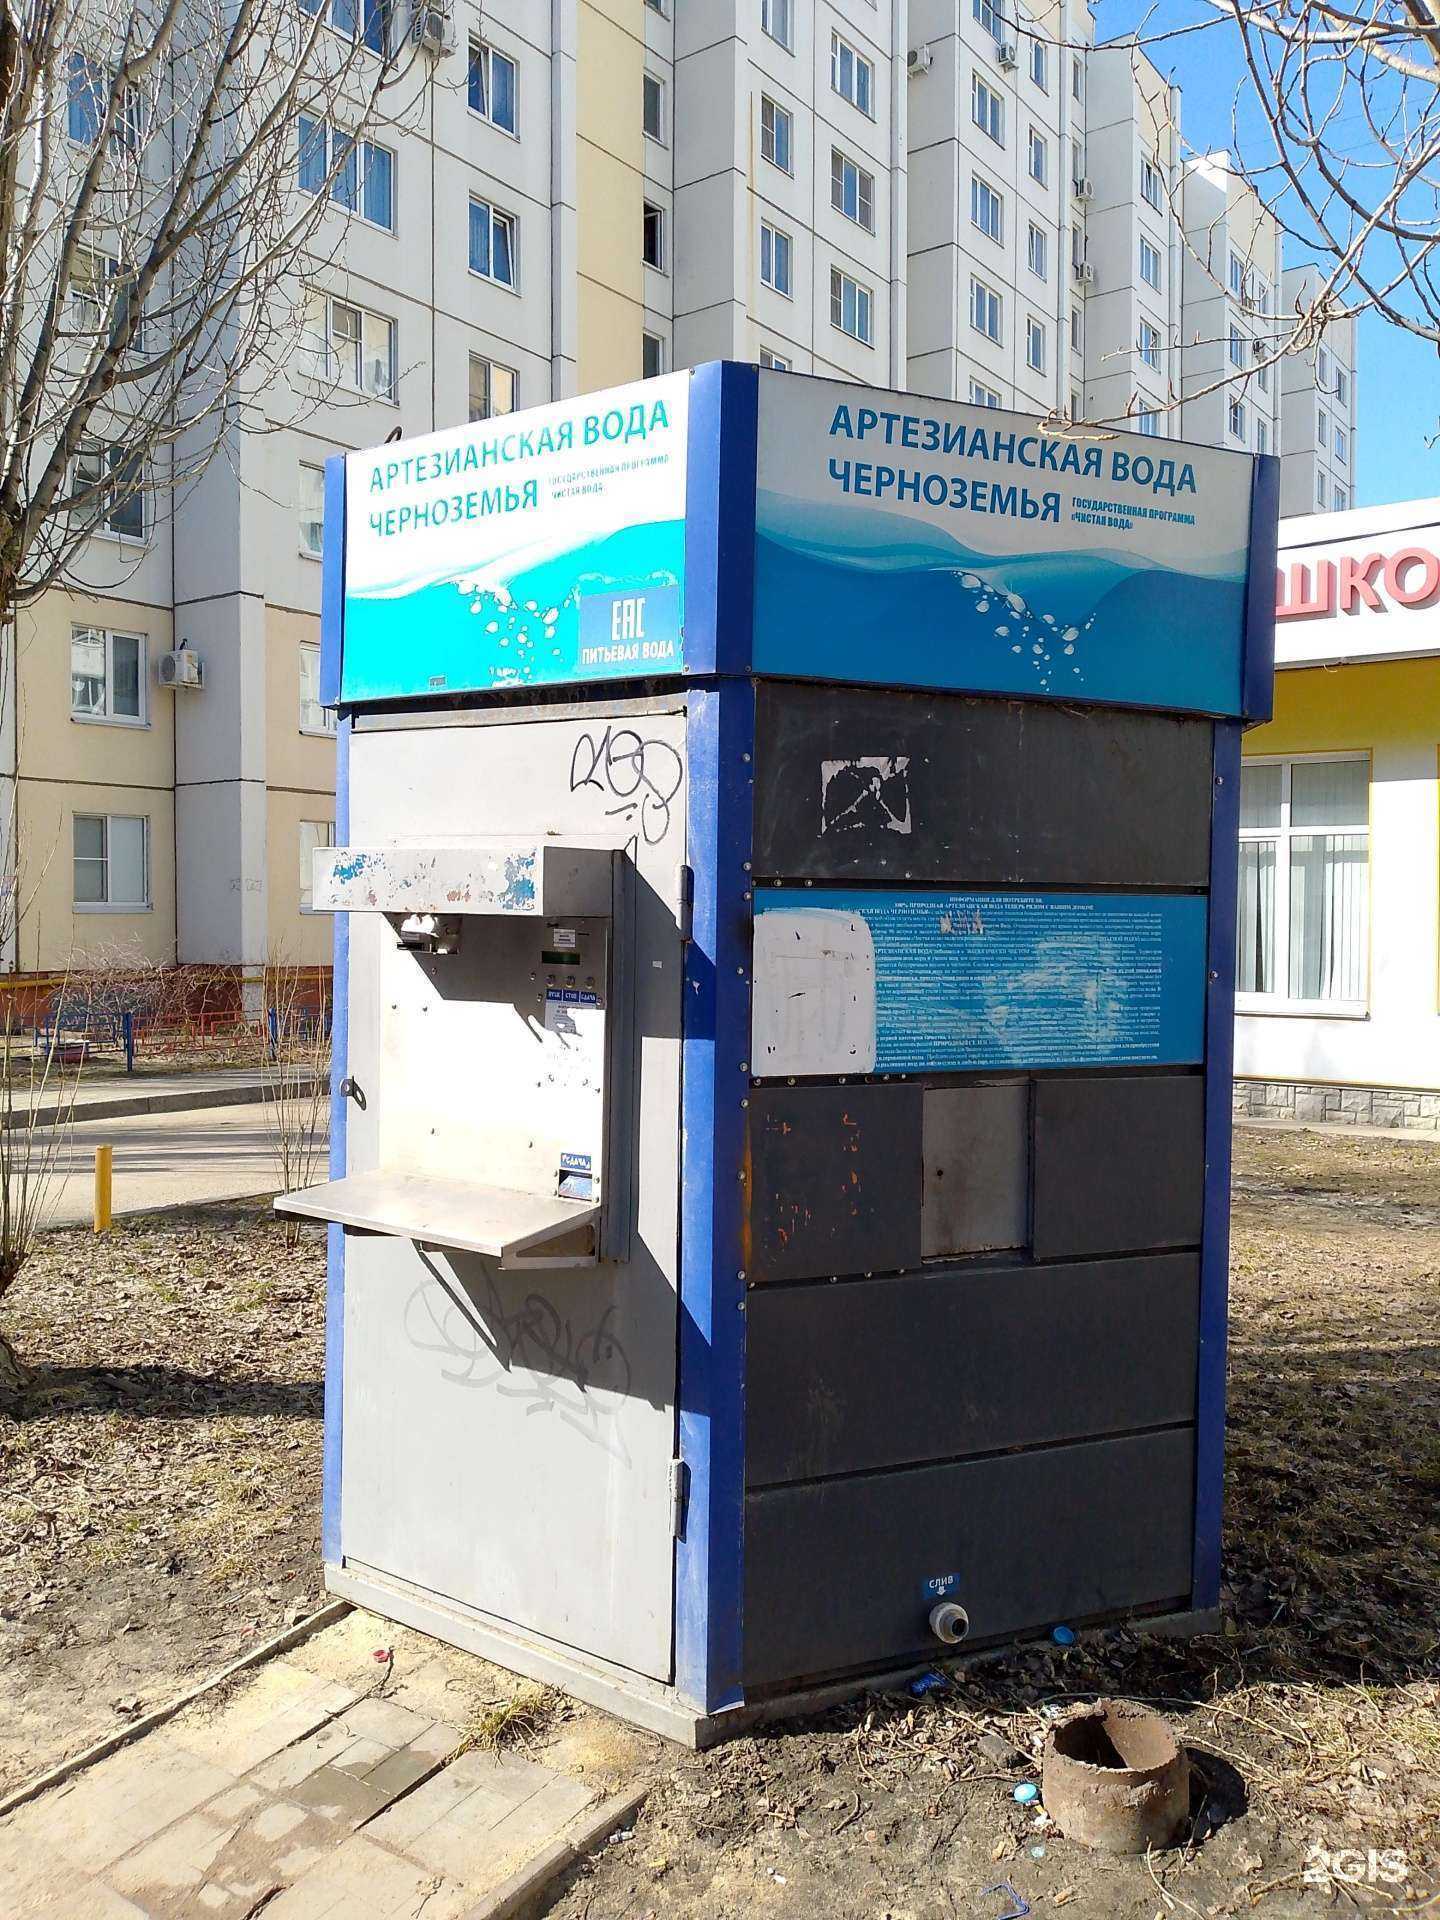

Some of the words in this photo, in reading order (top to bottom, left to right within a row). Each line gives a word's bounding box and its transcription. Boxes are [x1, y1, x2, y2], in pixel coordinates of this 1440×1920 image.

[370, 421, 573, 492] АРТЕЗИАНСКАЯ
[584, 400, 669, 446] ВОДА
[829, 404, 1102, 478] АРТЕЗИАНСКАЯ
[1111, 451, 1197, 497] ВОДА
[369, 479, 538, 537] ЧЕРНОЗЕМЬЯ
[828, 458, 1061, 523] ЧЕРНОЗЕМЬЯ
[1072, 497, 1147, 518] ГОСУДАРСТВЕННАЯ
[1149, 509, 1195, 525] ПРОГРАММА
[582, 643, 640, 665] ПИТЬЕВАЯ
[642, 640, 674, 659] ВОДА
[929, 1575, 954, 1589] СЛИВ
